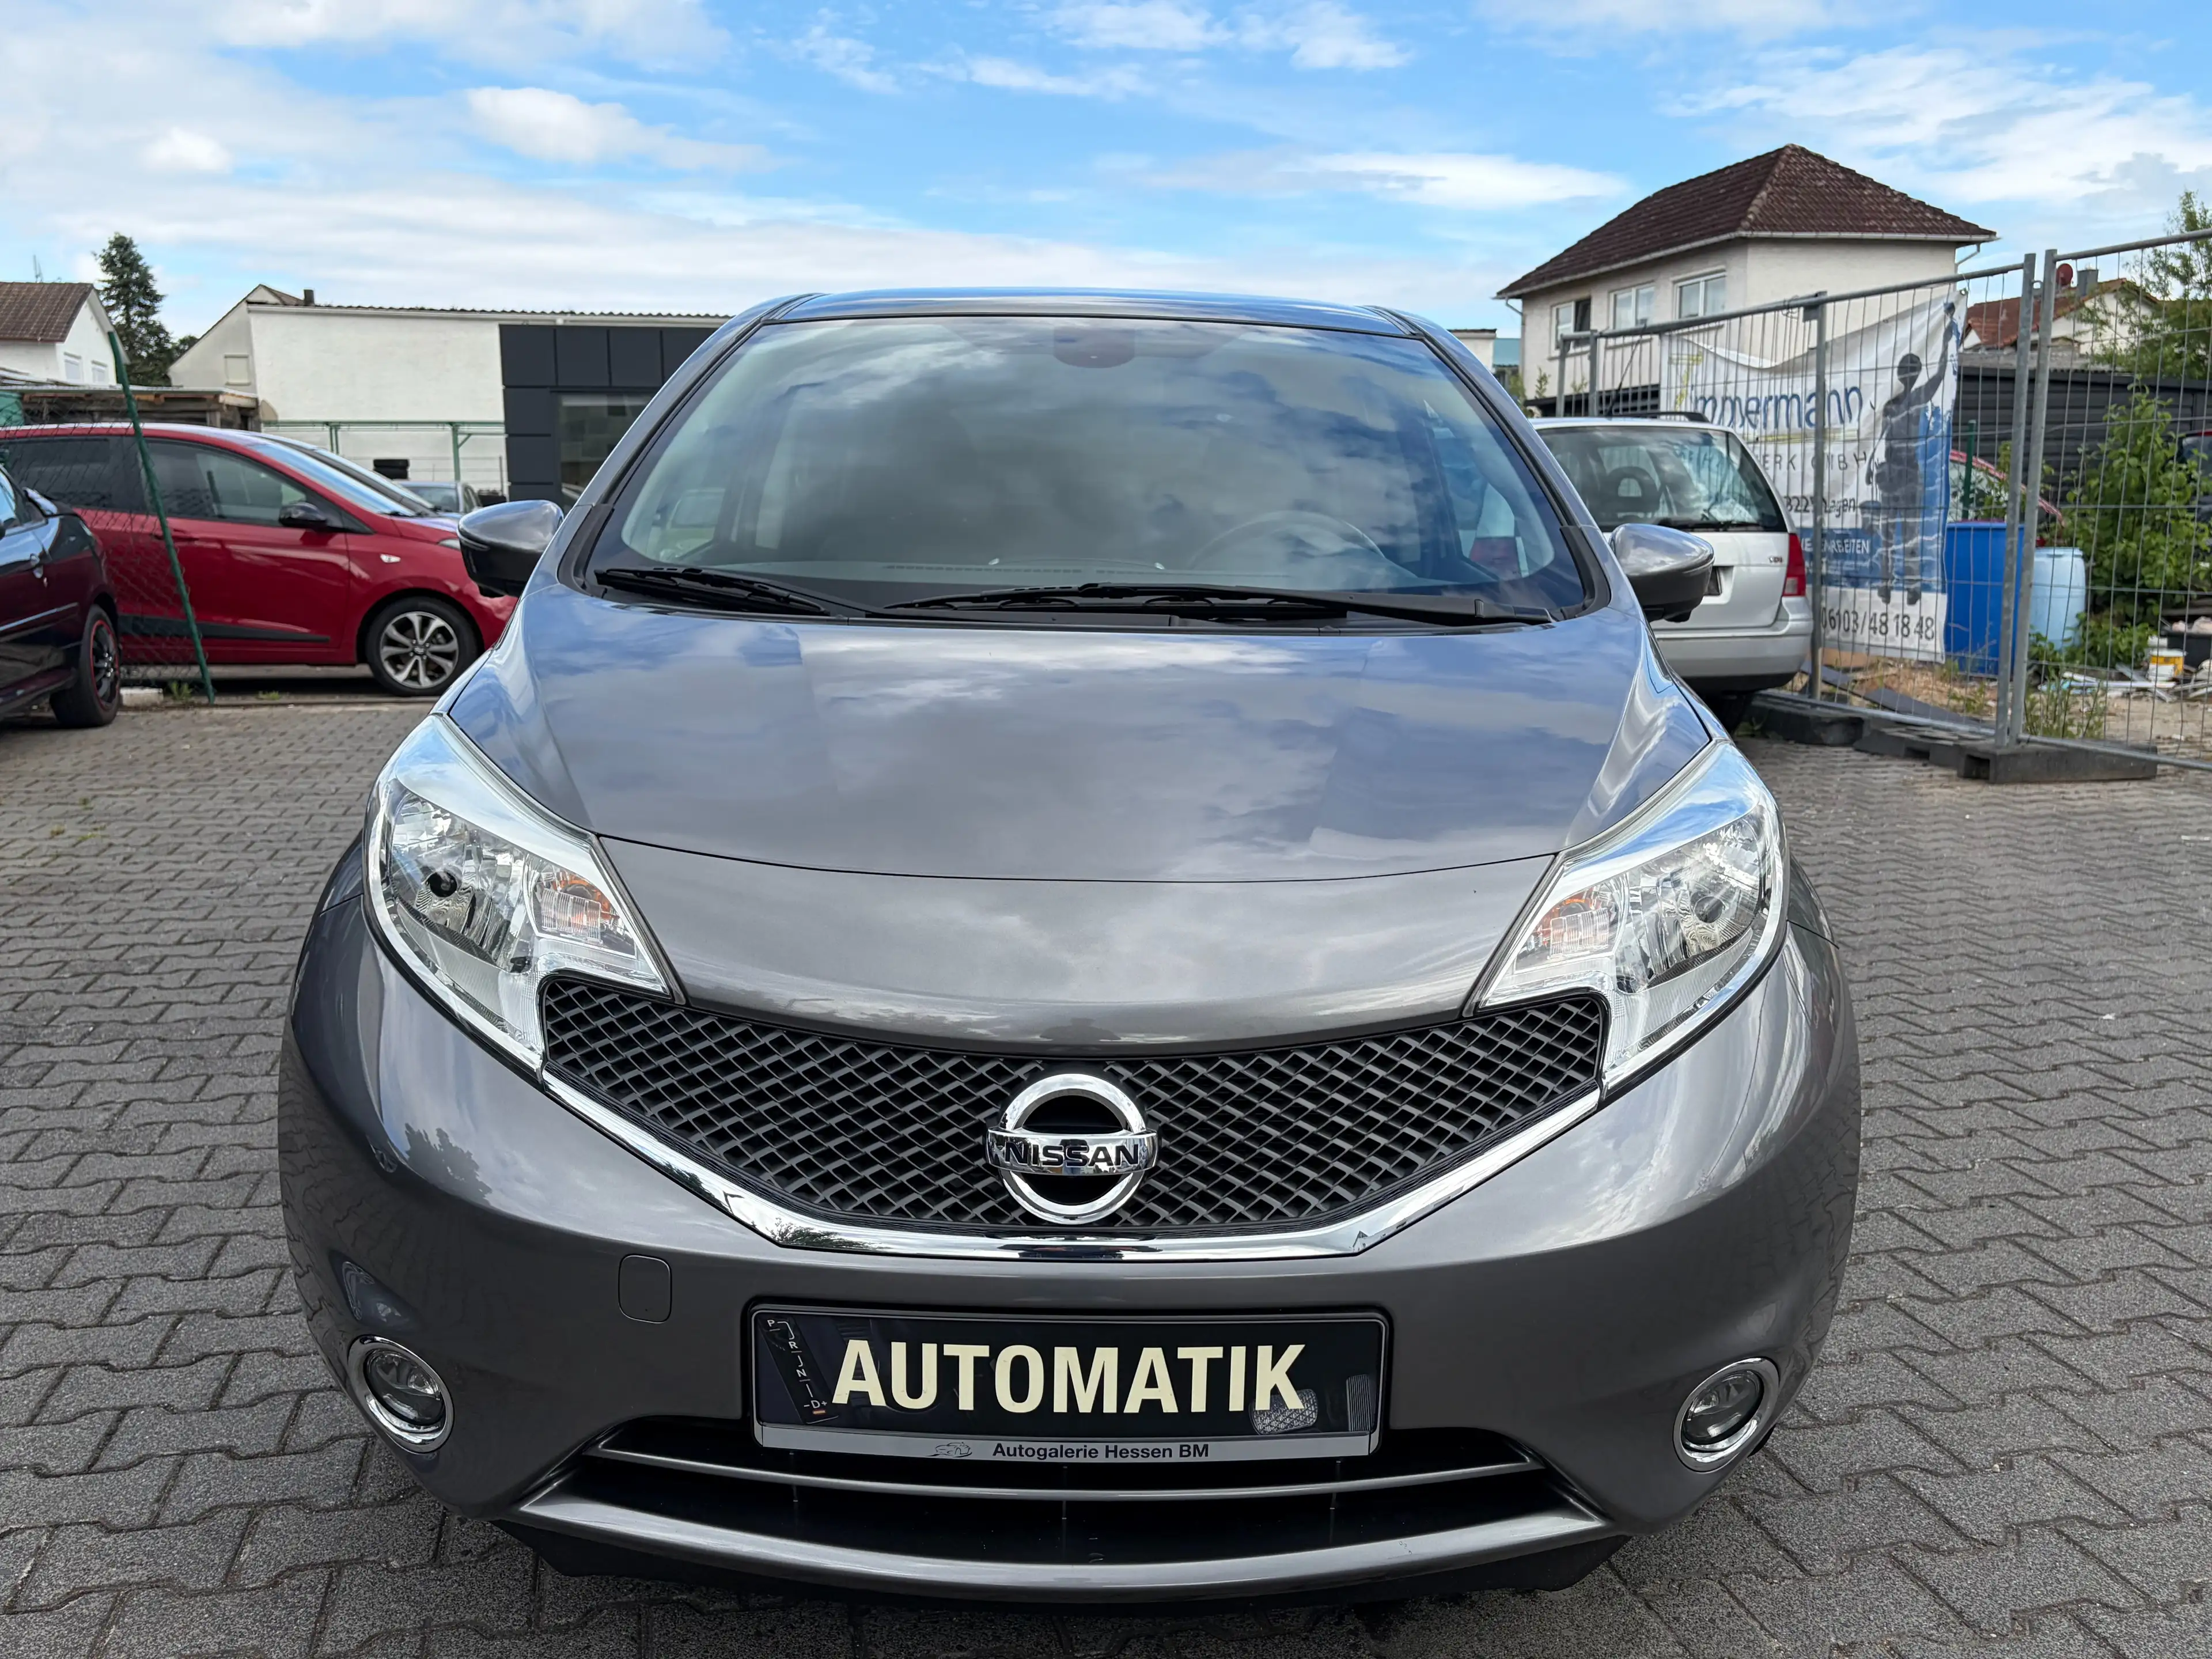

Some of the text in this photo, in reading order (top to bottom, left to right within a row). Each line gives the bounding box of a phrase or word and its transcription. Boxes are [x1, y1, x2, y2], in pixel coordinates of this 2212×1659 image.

[1004, 1141, 1139, 1168] NISSAN
[832, 1340, 1305, 1412] AUTOMATIK
[992, 1443, 1209, 1460] Autogalerie Hessen BM
